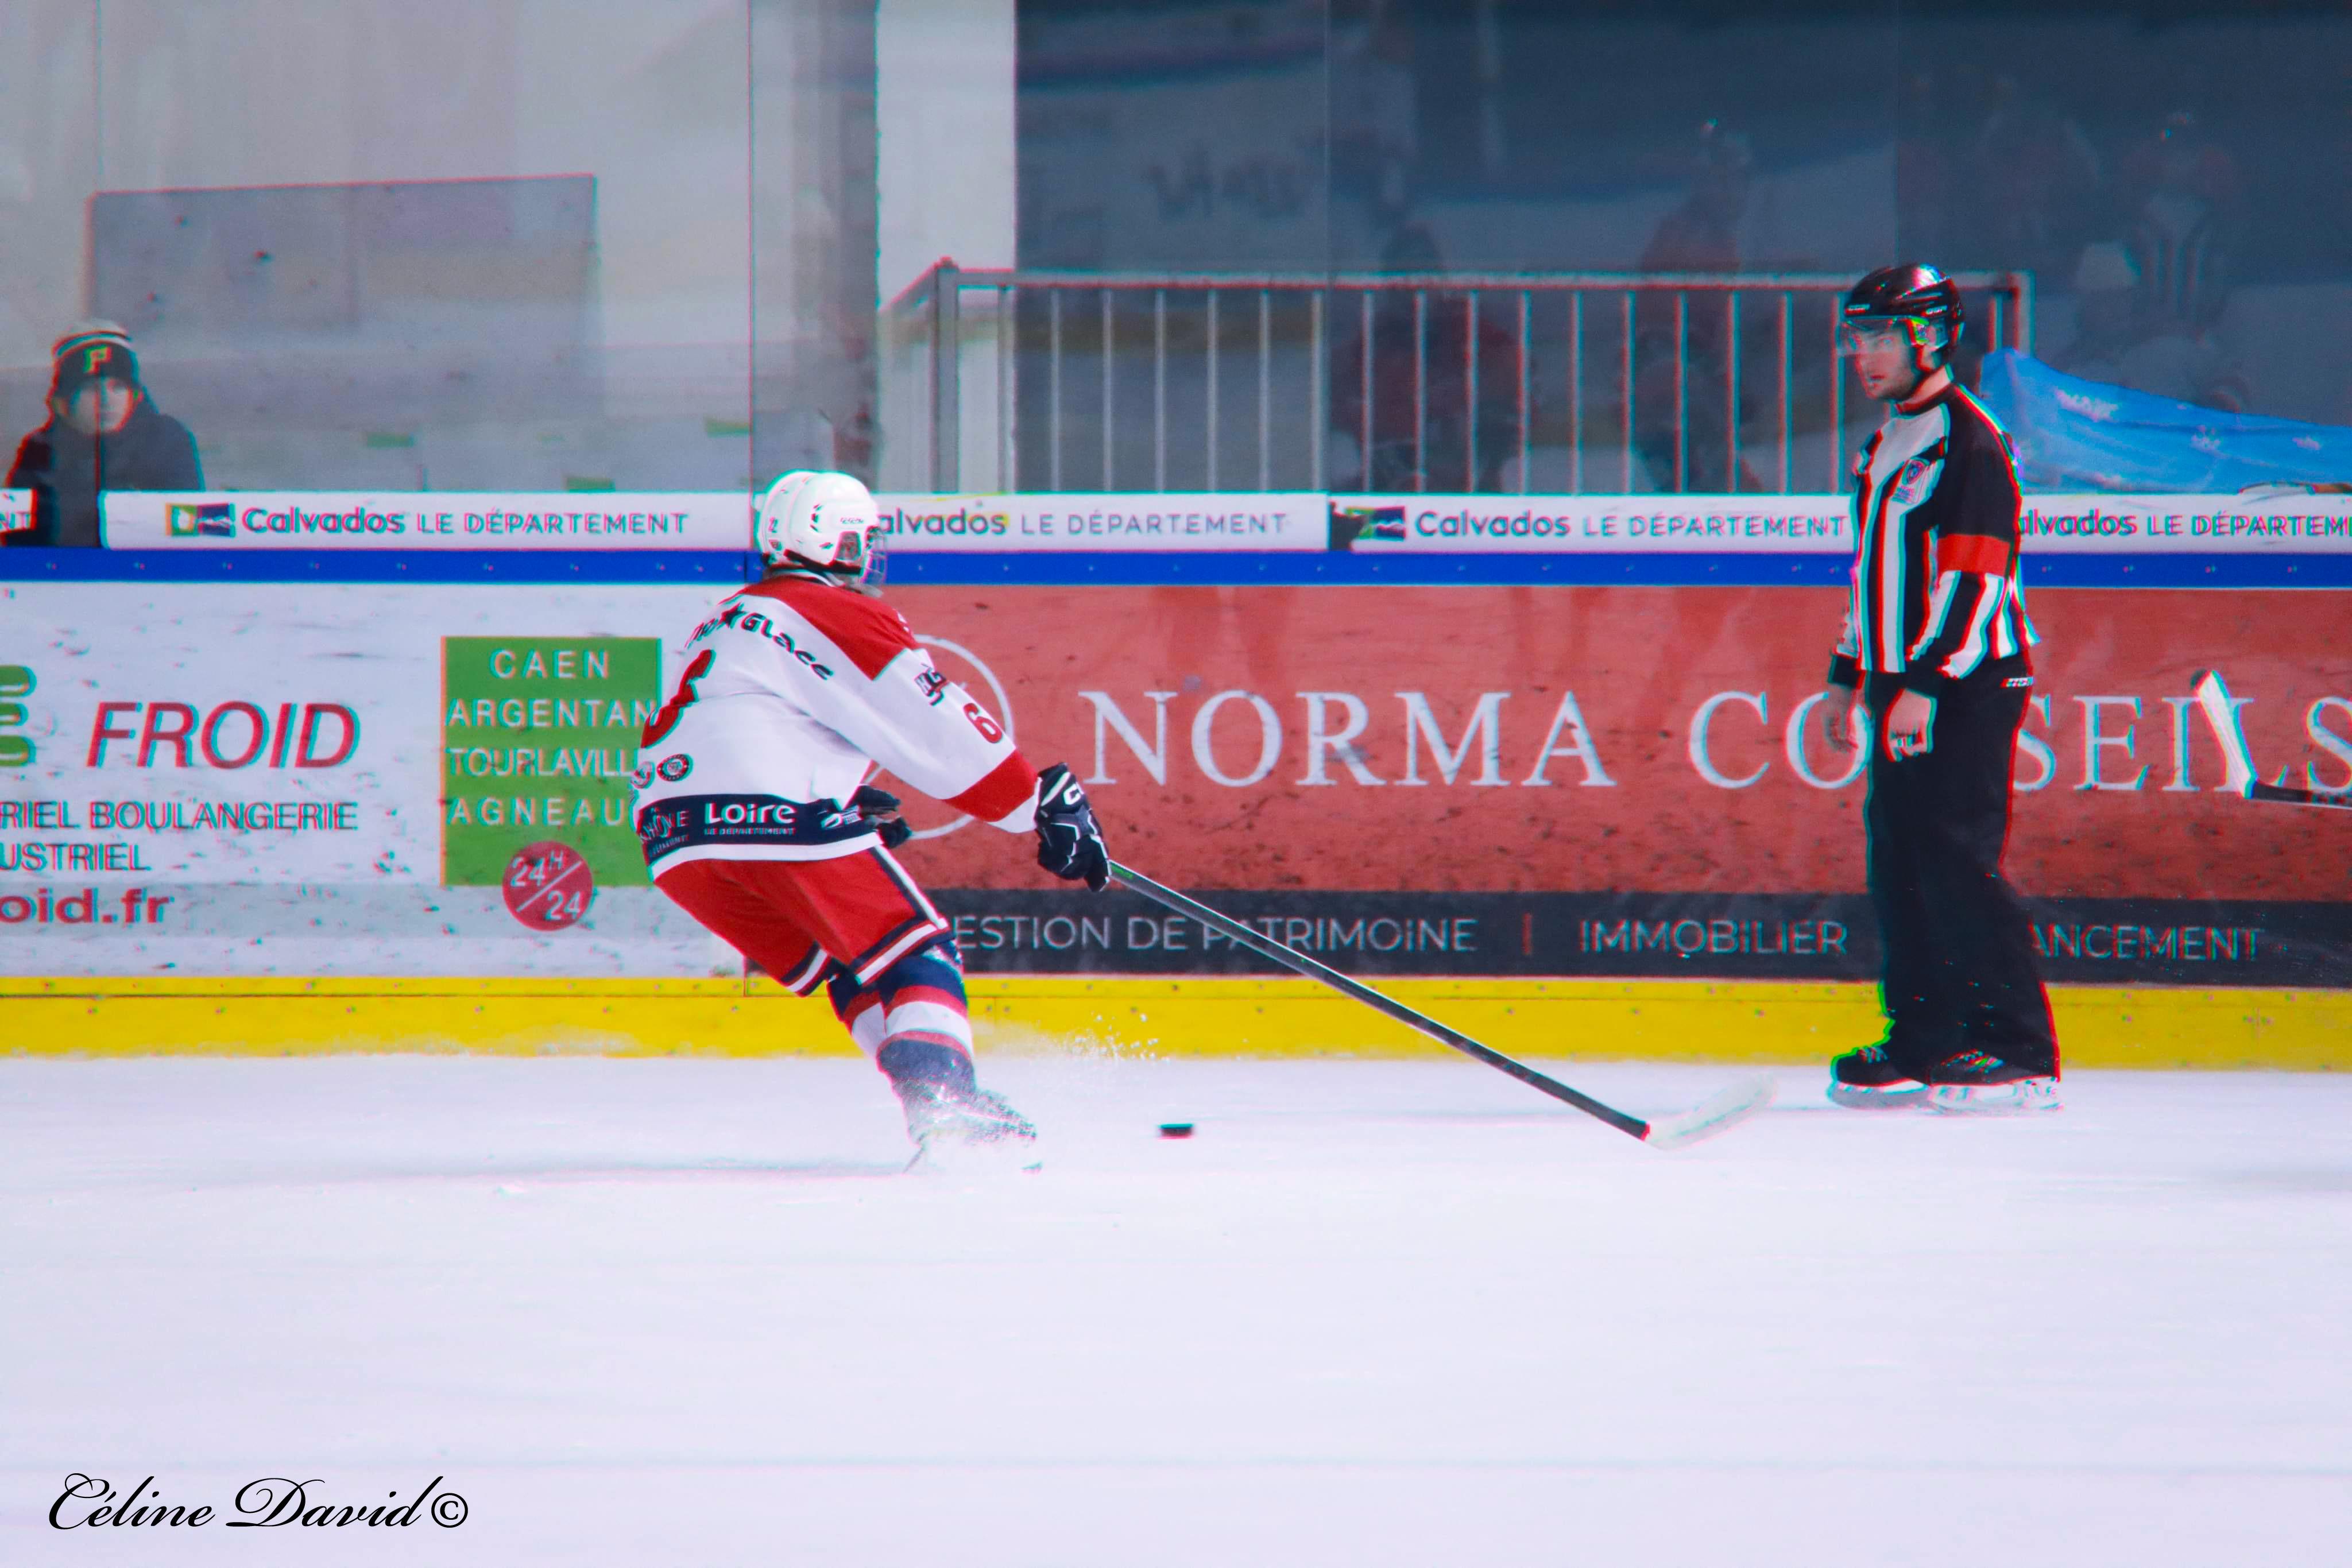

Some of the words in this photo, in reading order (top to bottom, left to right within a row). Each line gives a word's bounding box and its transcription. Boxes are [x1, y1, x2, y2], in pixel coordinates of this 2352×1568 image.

[242, 505, 407, 535] Calvados
[416, 514, 454, 535] LE
[464, 509, 689, 535] DÉPARTEMENT
[877, 507, 1007, 535] alvados
[1022, 514, 1054, 534] LE
[1067, 509, 1287, 535] DÉPARTEMENT
[1415, 509, 1570, 536] Calvados
[1583, 516, 1618, 536] LE
[1628, 510, 1850, 537] DÉPARTEMENT
[2018, 509, 2138, 536] alvados
[2147, 514, 2184, 536] LE
[2191, 510, 2352, 537] DÉPARTEM
[489, 649, 609, 679] CAEN
[445, 698, 657, 728] ARGENTAN
[962, 702, 1004, 744] 6
[86, 700, 361, 769] FROID
[1077, 689, 1617, 787] NORMA
[1688, 690, 2352, 793] COSEIS
[445, 747, 635, 778] TOURLAVILL
[0, 800, 80, 830] RIEL
[88, 800, 358, 830] BOULANGERIE
[447, 797, 627, 827] AGNEAU
[704, 803, 796, 824] Loire
[0, 888, 174, 924] oid.fr
[546, 891, 582, 921] 24
[954, 916, 1111, 950] ESTION
[1127, 916, 1187, 950] DE
[1202, 917, 1479, 952] PTRIMOINE
[1580, 919, 1848, 955] IMMOBILIER
